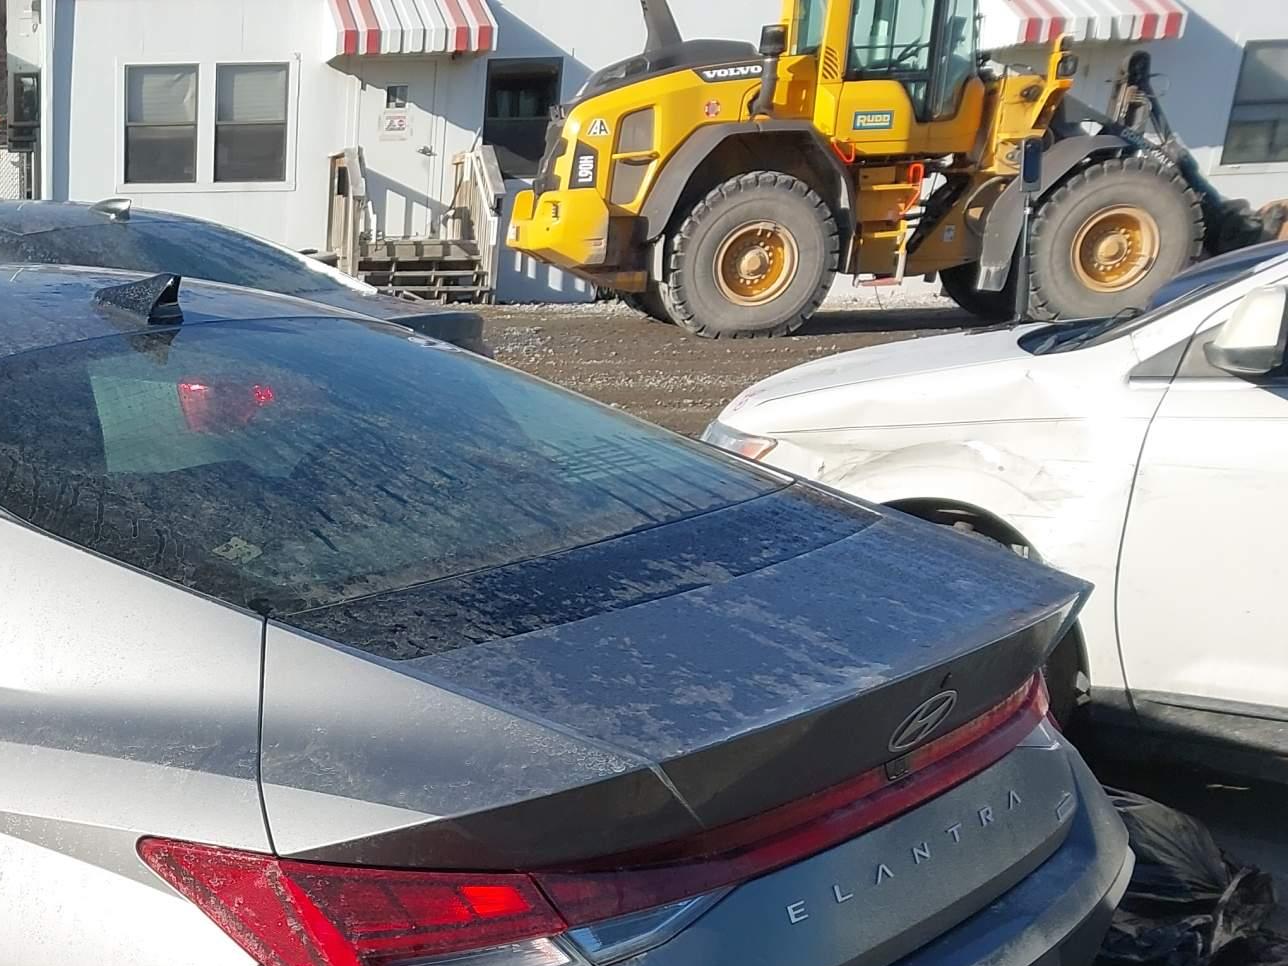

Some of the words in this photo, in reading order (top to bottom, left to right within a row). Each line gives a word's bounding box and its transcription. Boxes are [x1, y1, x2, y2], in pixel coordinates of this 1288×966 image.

[703, 65, 763, 78] VOLVO
[856, 114, 891, 127] RUDD
[578, 155, 594, 183] L90H
[787, 790, 1021, 924] ELANTRA
